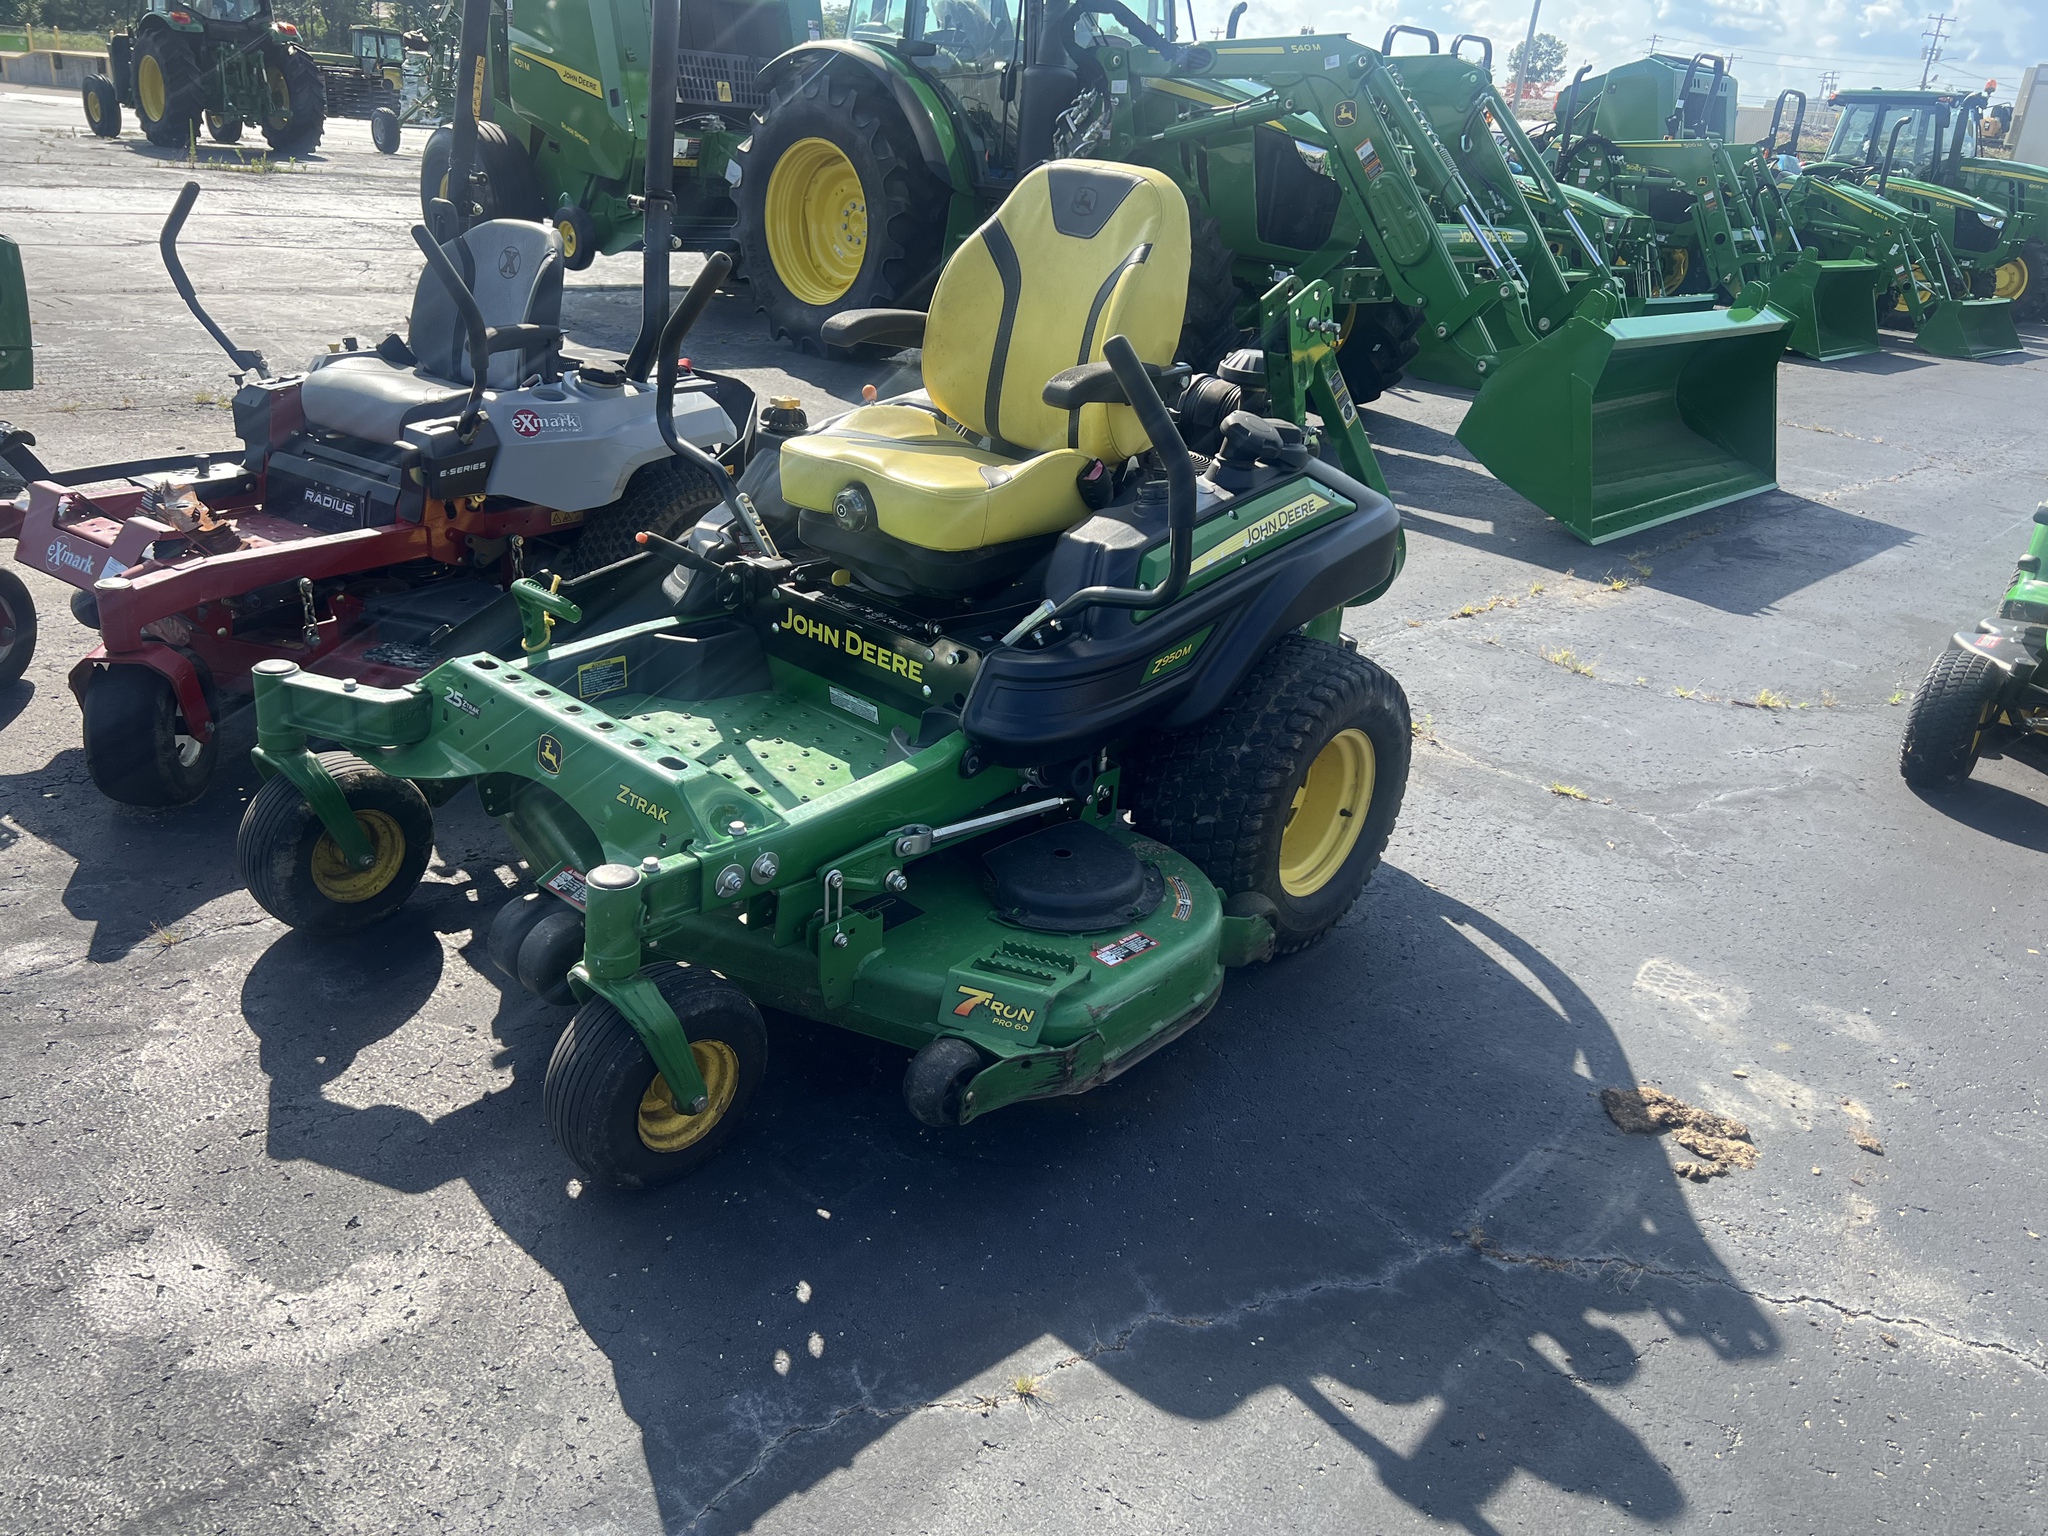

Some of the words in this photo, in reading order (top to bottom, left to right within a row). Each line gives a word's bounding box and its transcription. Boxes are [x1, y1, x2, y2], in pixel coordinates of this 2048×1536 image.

[1290, 44, 1311, 54] 540
[1312, 43, 1321, 51] M
[563, 70, 578, 83] JOHN
[578, 75, 598, 91] DEERE
[511, 414, 578, 433] eXmark
[304, 489, 355, 516] RADIUS
[1247, 517, 1277, 544] JOHN
[1278, 499, 1316, 527] DEERE
[47, 541, 95, 575] eXmark
[780, 607, 840, 649] JOHN
[845, 629, 924, 684] DEERE
[1151, 643, 1193, 675] Z950M
[443, 685, 464, 708] 25
[616, 784, 670, 825] ZTRAK
[991, 1017, 1013, 1028] PRO
[1014, 1023, 1029, 1032] 60
